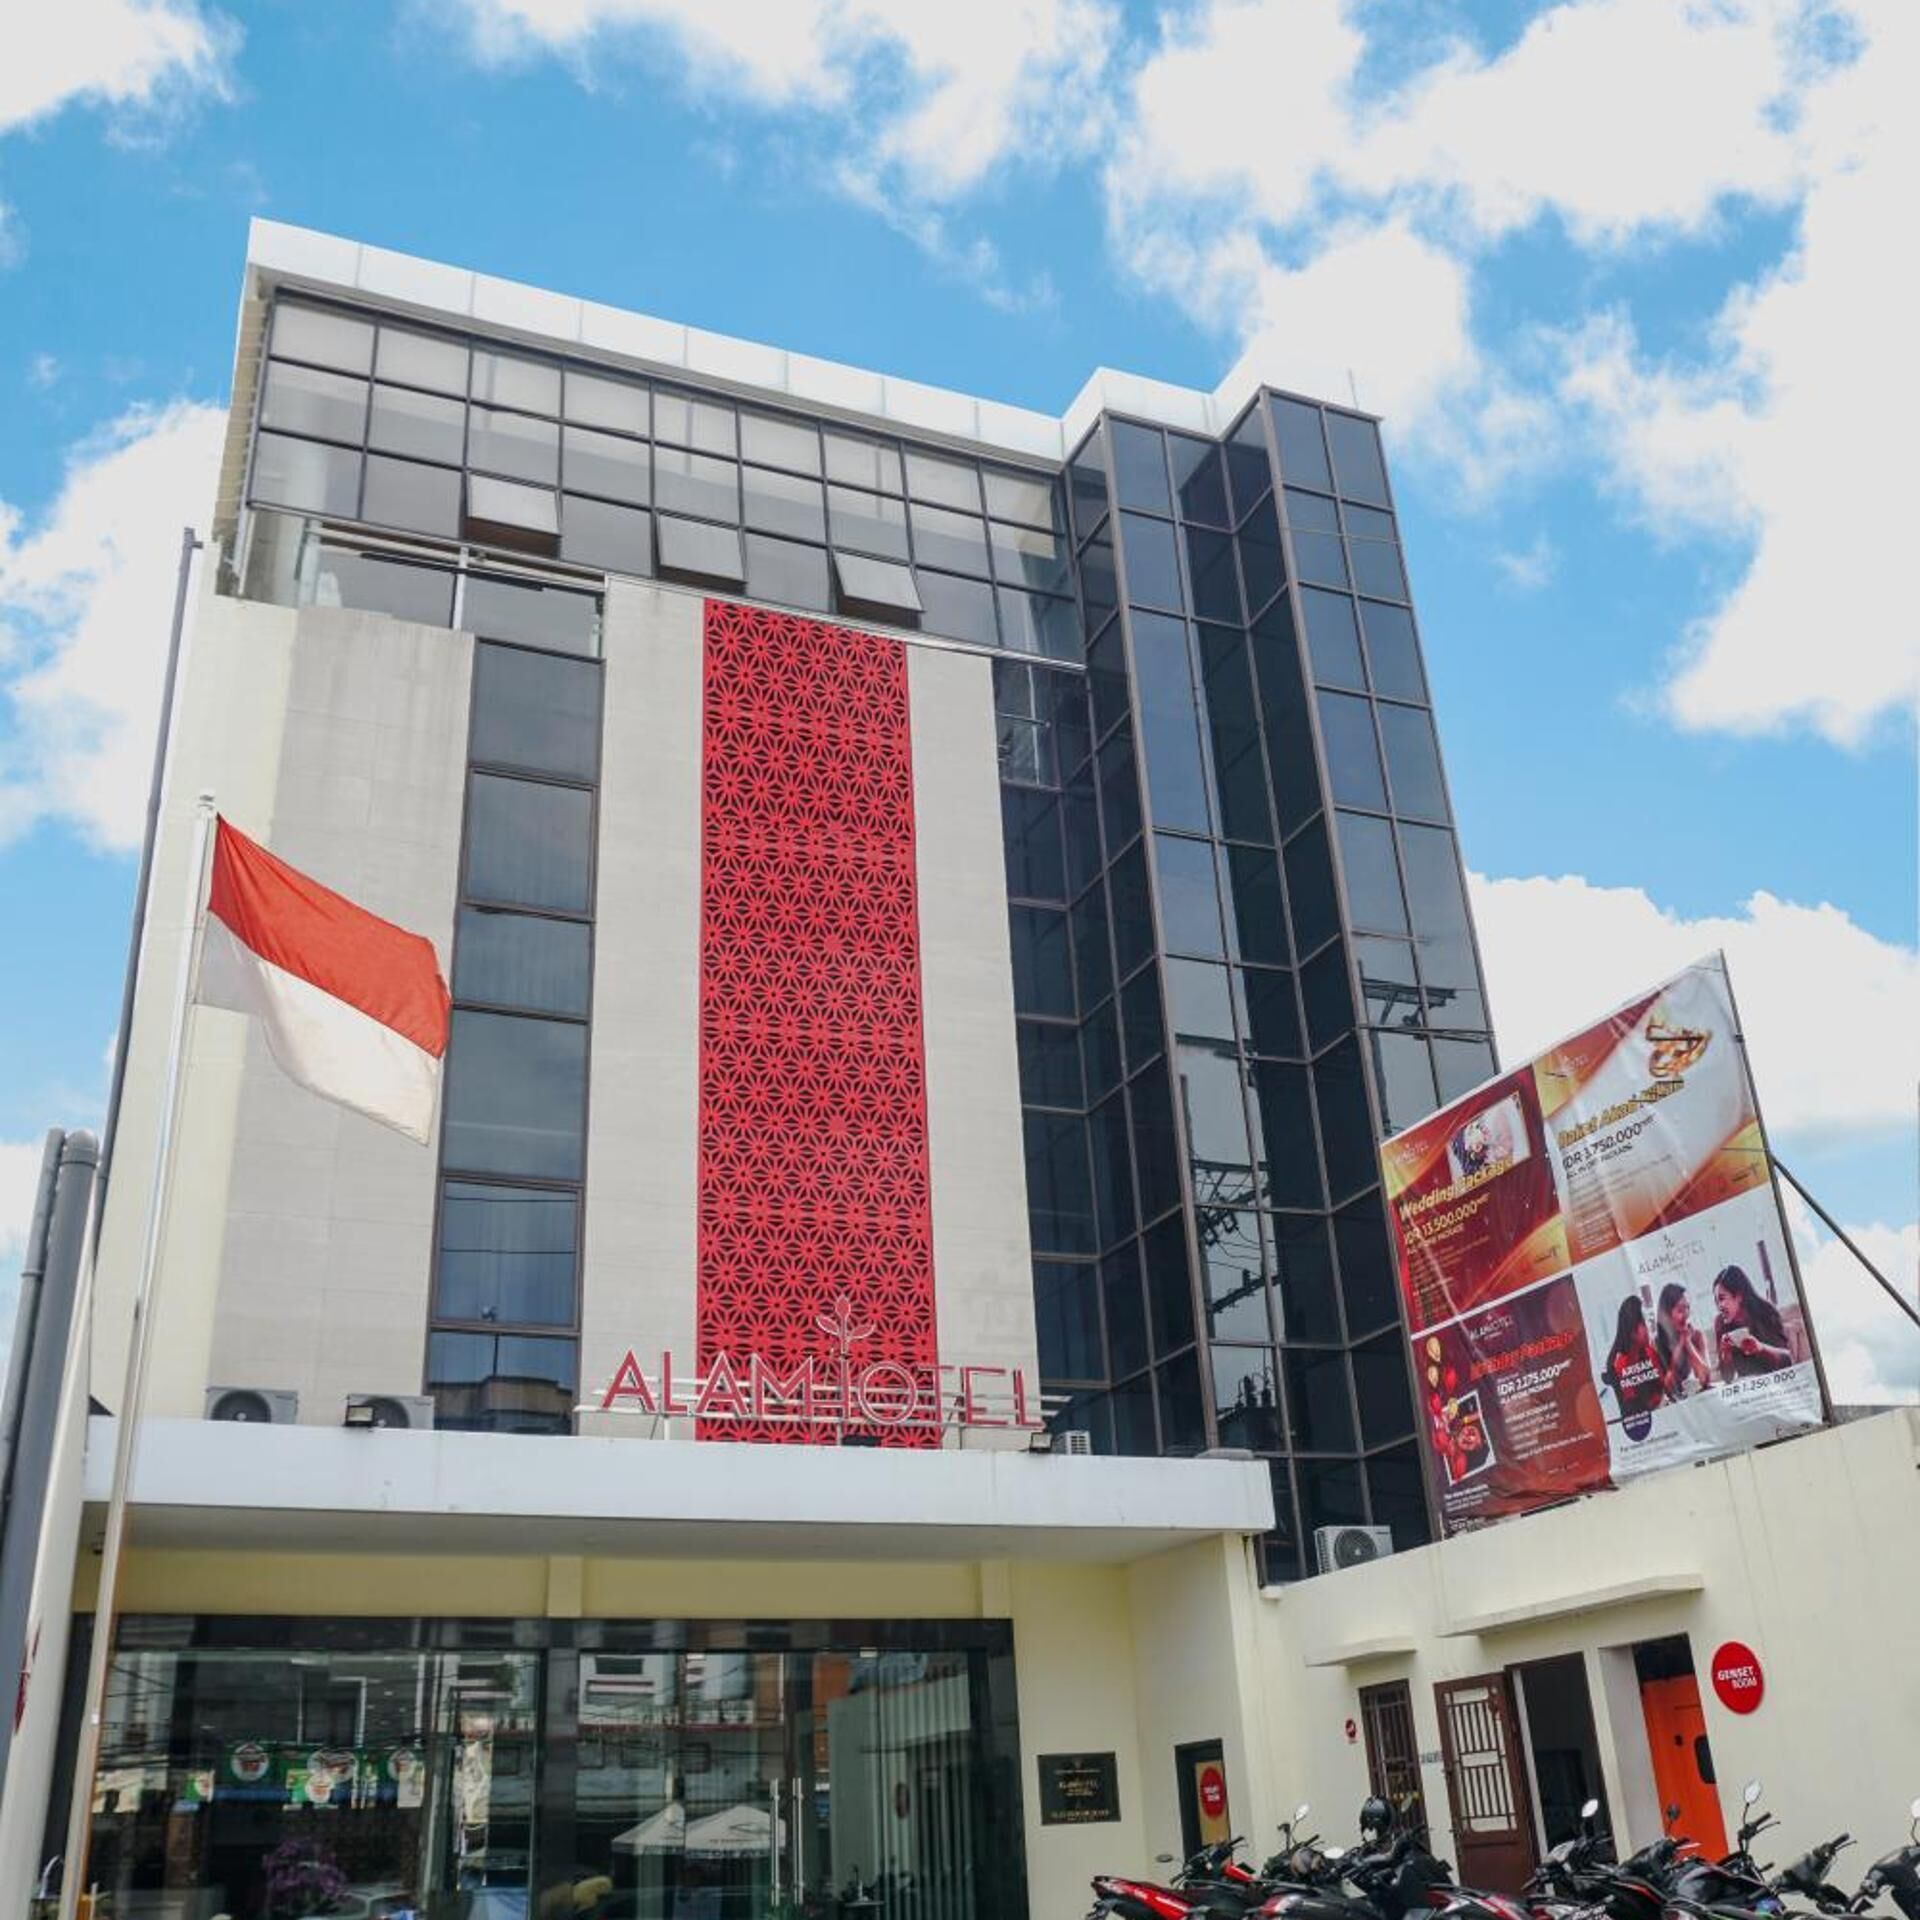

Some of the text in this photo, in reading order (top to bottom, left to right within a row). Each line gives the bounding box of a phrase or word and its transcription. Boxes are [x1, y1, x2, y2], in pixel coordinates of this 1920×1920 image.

[1562, 1150, 1583, 1169] IDR
[1399, 1184, 1455, 1221] Wedding
[1621, 1359, 1654, 1377] ARISAN
[1620, 1368, 1660, 1388] PACKAGE
[1497, 1381, 1517, 1396] IDR
[1721, 1385, 1741, 1400] IDR
[1718, 1666, 1753, 1680] GENSET
